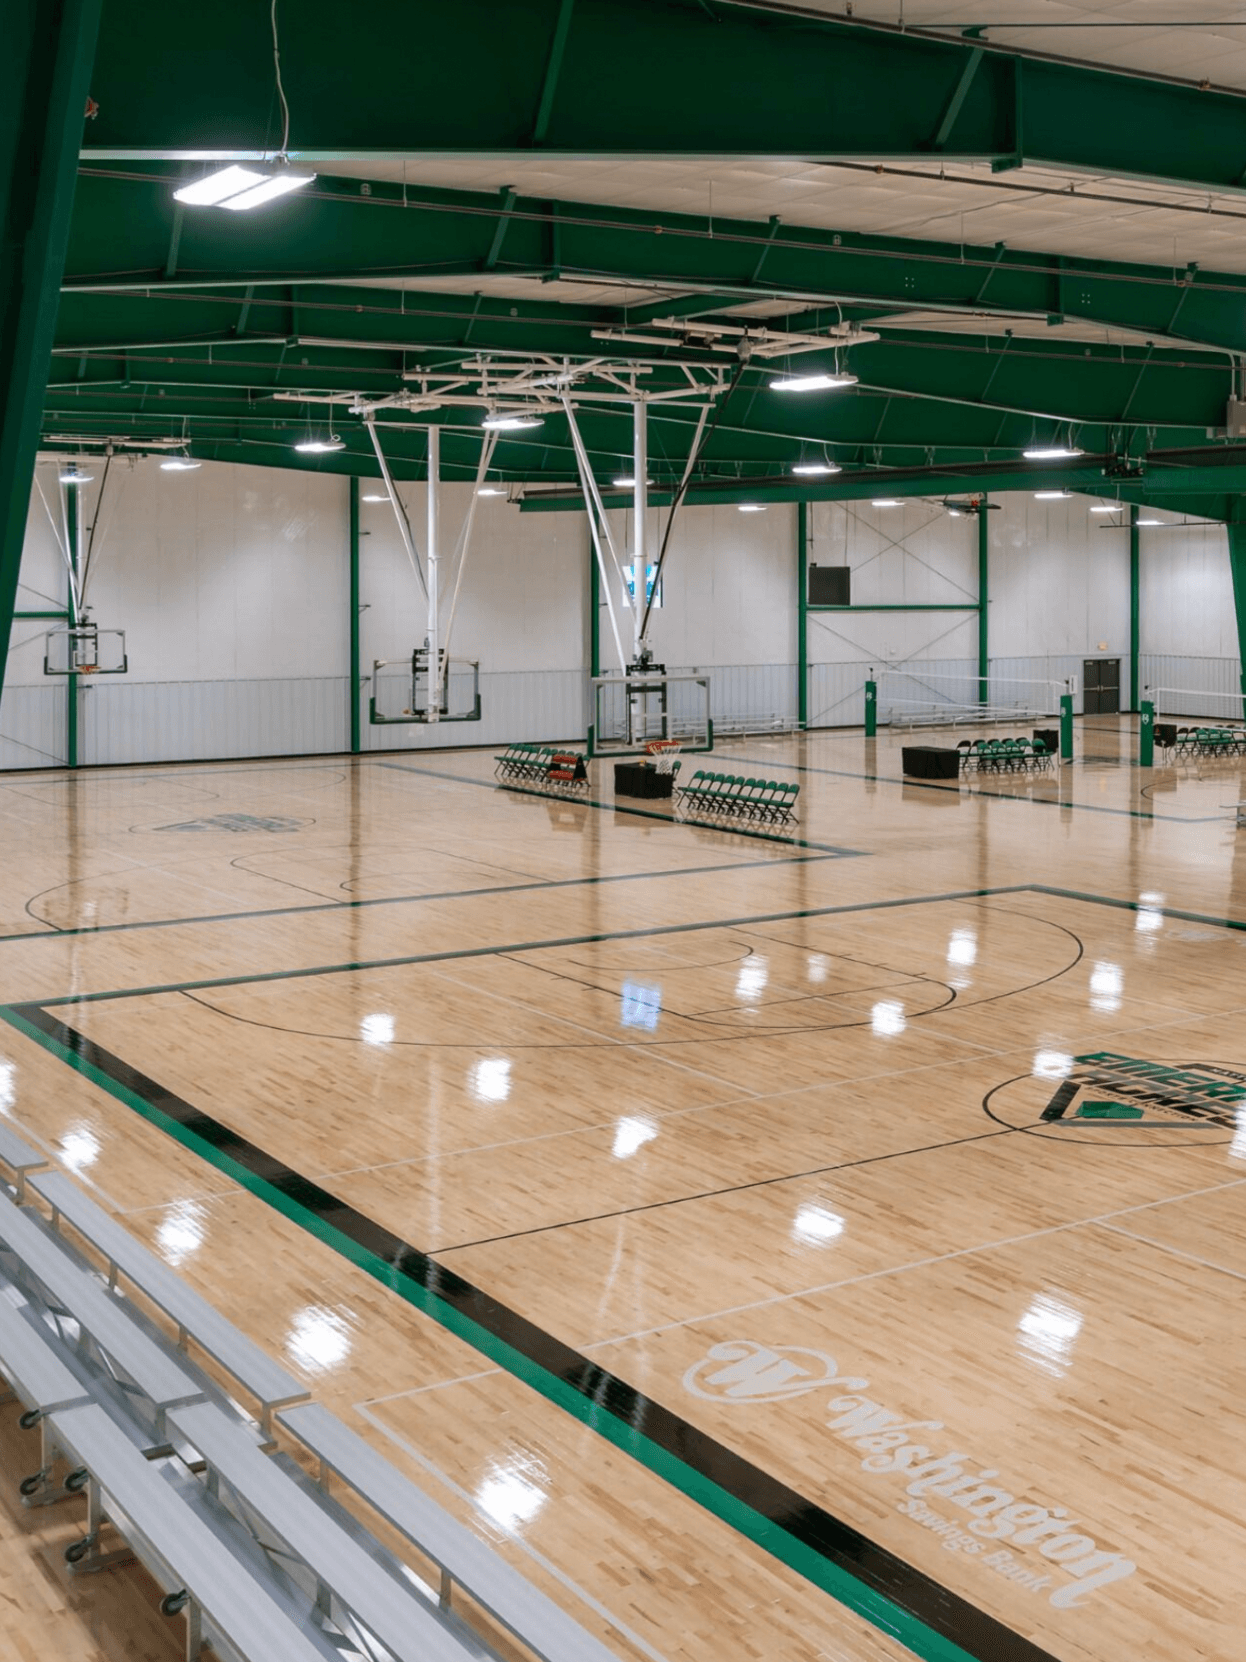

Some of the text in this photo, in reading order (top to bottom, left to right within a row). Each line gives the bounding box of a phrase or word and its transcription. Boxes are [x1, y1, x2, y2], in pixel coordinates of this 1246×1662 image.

[825, 1395, 1136, 1608] Washington
[897, 1500, 1052, 1593] Savings Bank
